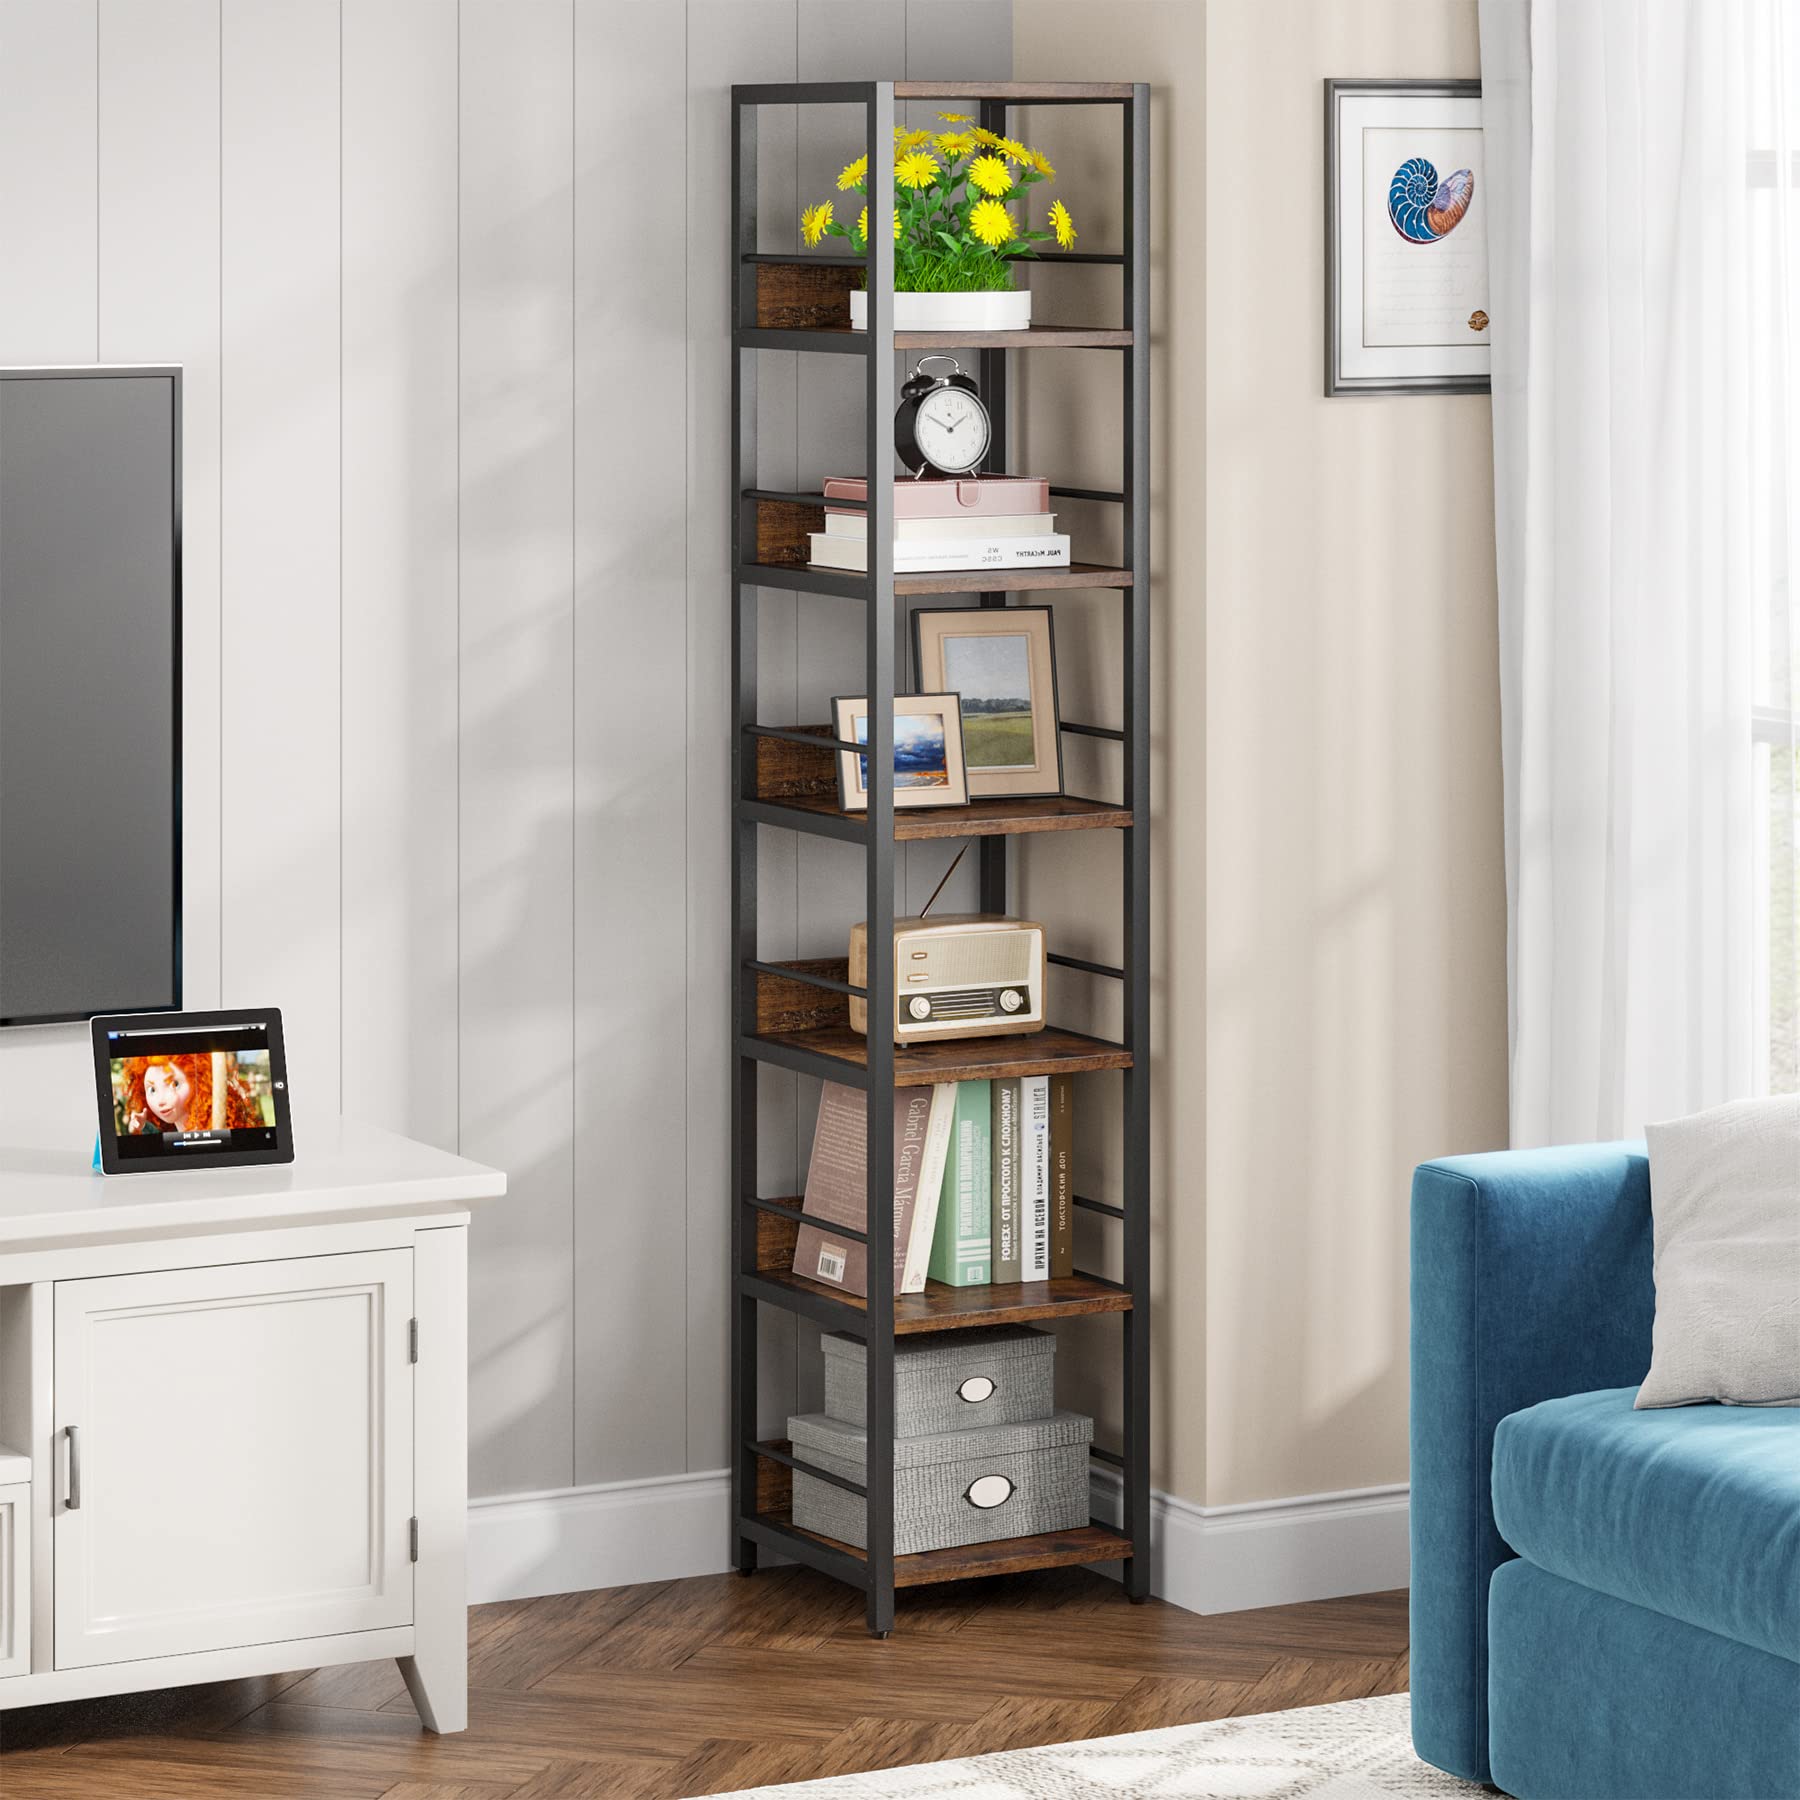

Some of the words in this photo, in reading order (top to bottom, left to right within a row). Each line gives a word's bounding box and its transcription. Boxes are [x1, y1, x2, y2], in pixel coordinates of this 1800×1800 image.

[904, 1098, 928, 1141] Gabriel
[1001, 1089, 1011, 1146] СЛОЖНОМУ
[1002, 1157, 1011, 1206] ПРОСТОГО
[1002, 1209, 1011, 1220] ОТ
[1001, 1223, 1011, 1261] FOREX:
[1035, 1229, 1045, 1239] НА
[1035, 1241, 1045, 1269] ПРЯТКИ
